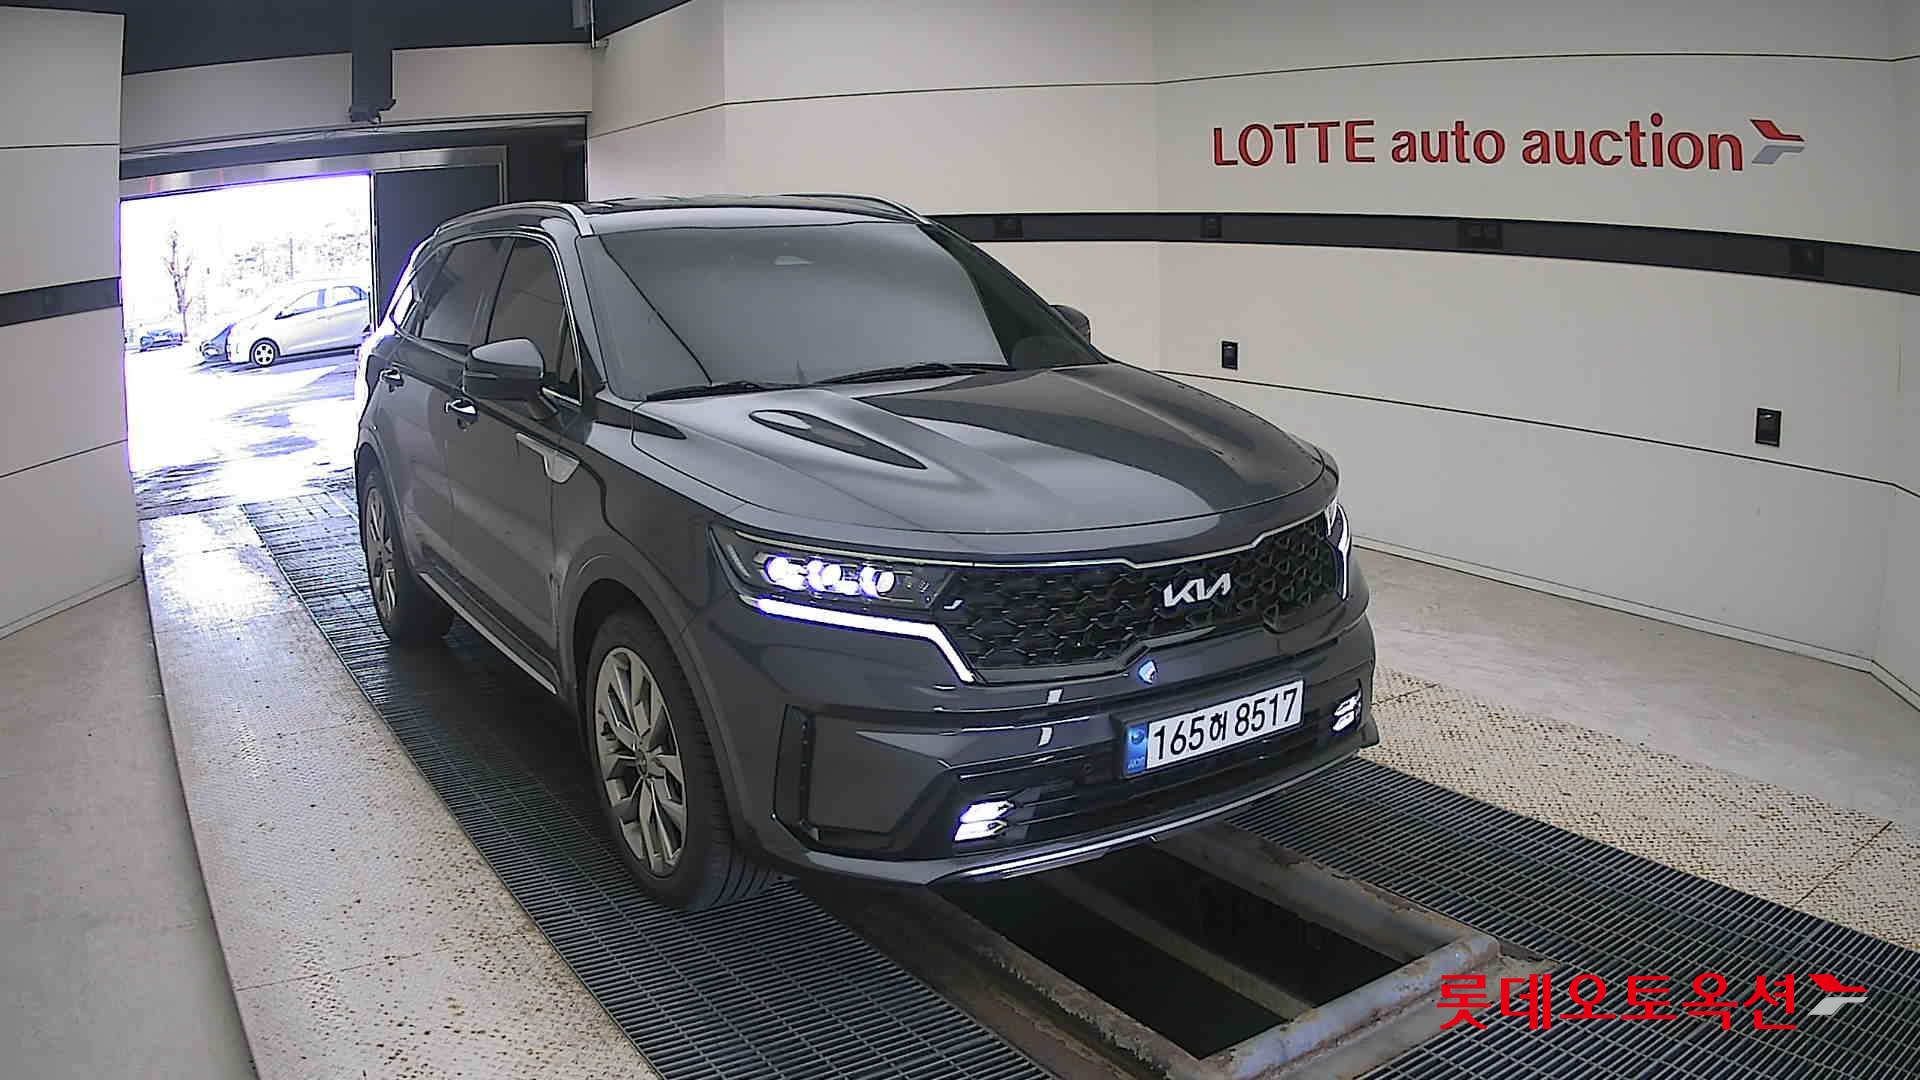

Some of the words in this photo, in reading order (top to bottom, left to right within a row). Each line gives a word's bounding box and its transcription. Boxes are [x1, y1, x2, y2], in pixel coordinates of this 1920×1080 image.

[1213, 120, 1376, 167] LOTTE
[1391, 121, 1506, 165] auto
[1521, 112, 1745, 171] auction
[1162, 572, 1232, 608] KIA
[1153, 710, 1228, 761] 165허
[1234, 687, 1298, 737] 8517
